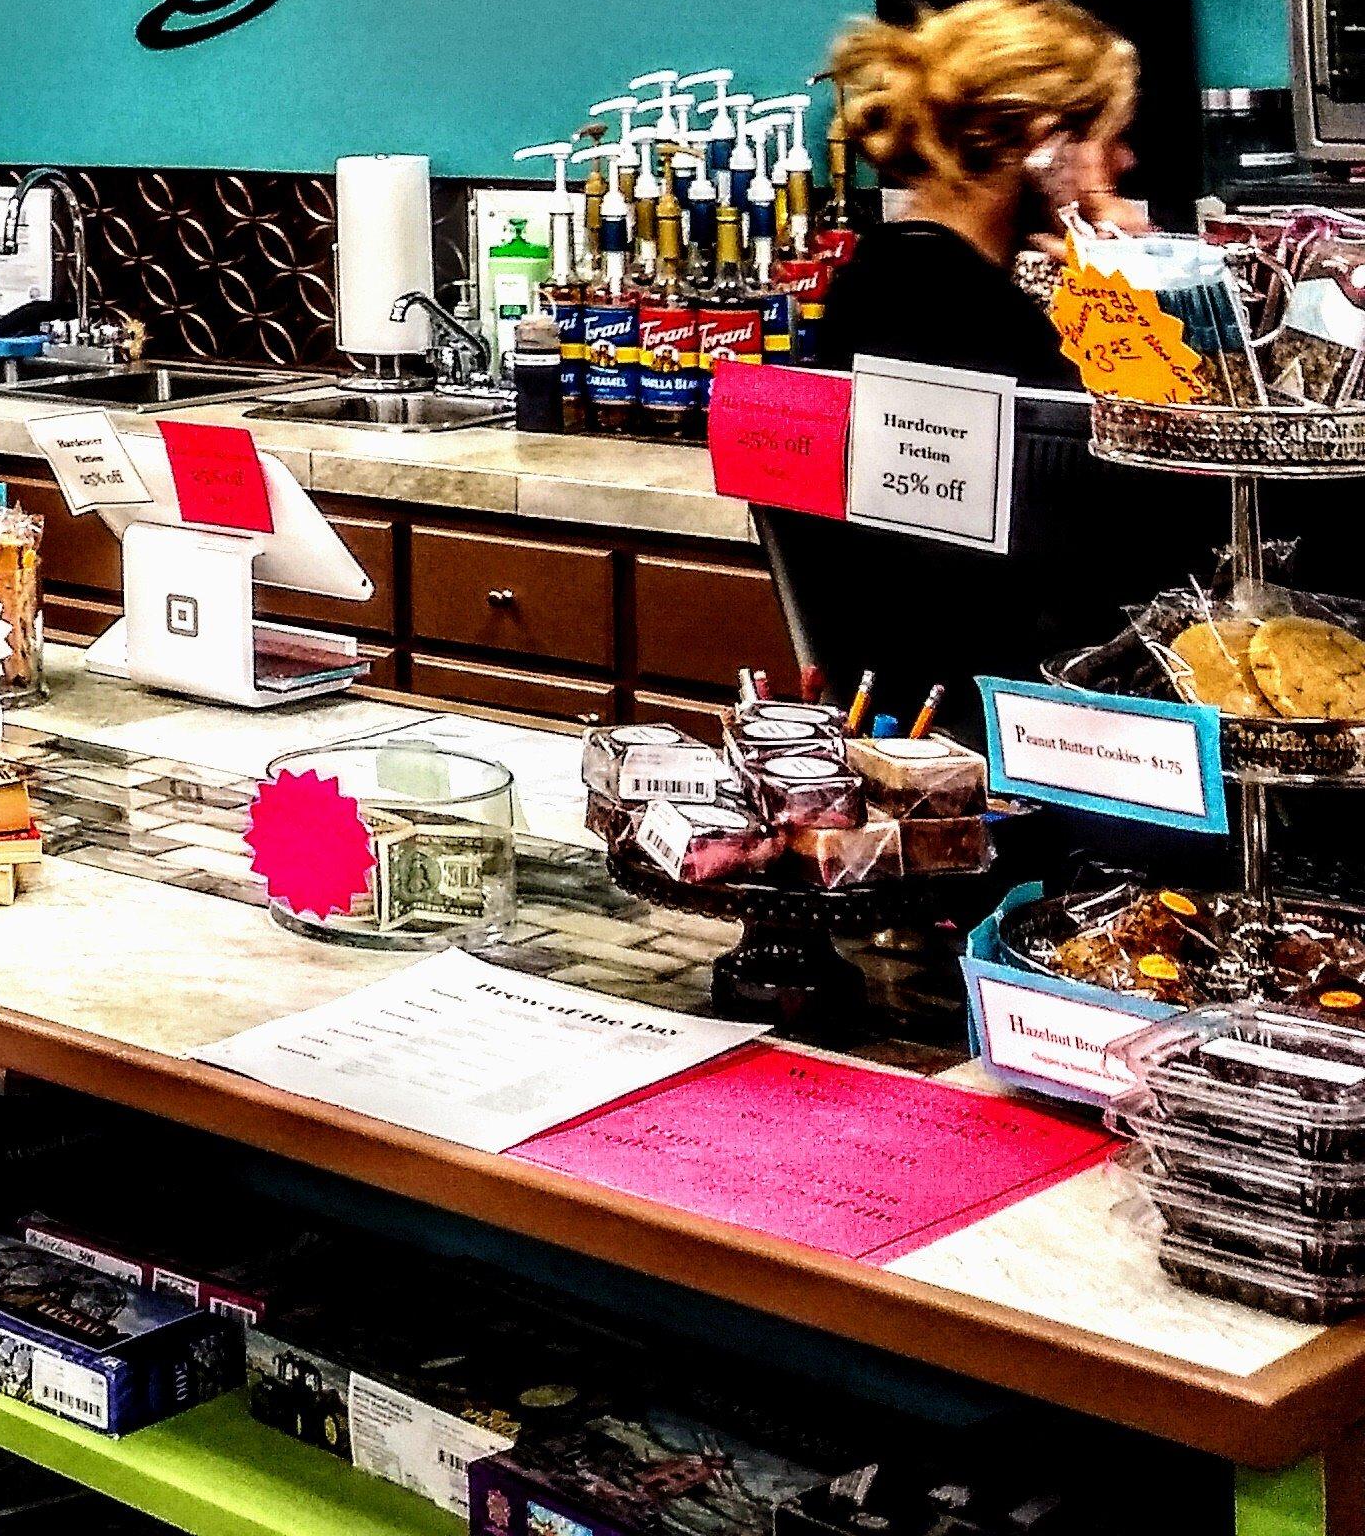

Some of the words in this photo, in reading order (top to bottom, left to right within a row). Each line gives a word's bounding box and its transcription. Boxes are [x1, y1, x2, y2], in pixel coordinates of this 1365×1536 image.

[583, 314, 635, 342] Torani
[639, 320, 698, 348] Torani
[698, 321, 755, 350] Torani
[883, 412, 968, 441] Hardcover
[738, 430, 779, 453] 25%
[783, 435, 813, 456] off
[898, 440, 952, 465] Fiction
[882, 471, 930, 497] 25%
[935, 478, 967, 503] off
[1014, 724, 1057, 750] Peanut
[1058, 736, 1095, 758] Butter
[1096, 743, 1143, 766] Cookies
[1150, 754, 1183, 777] $1.75
[475, 982, 544, 1008] Brew
[547, 1003, 578, 1016] of
[578, 1010, 625, 1027] the
[1009, 1014, 1073, 1049] Hazelnut
